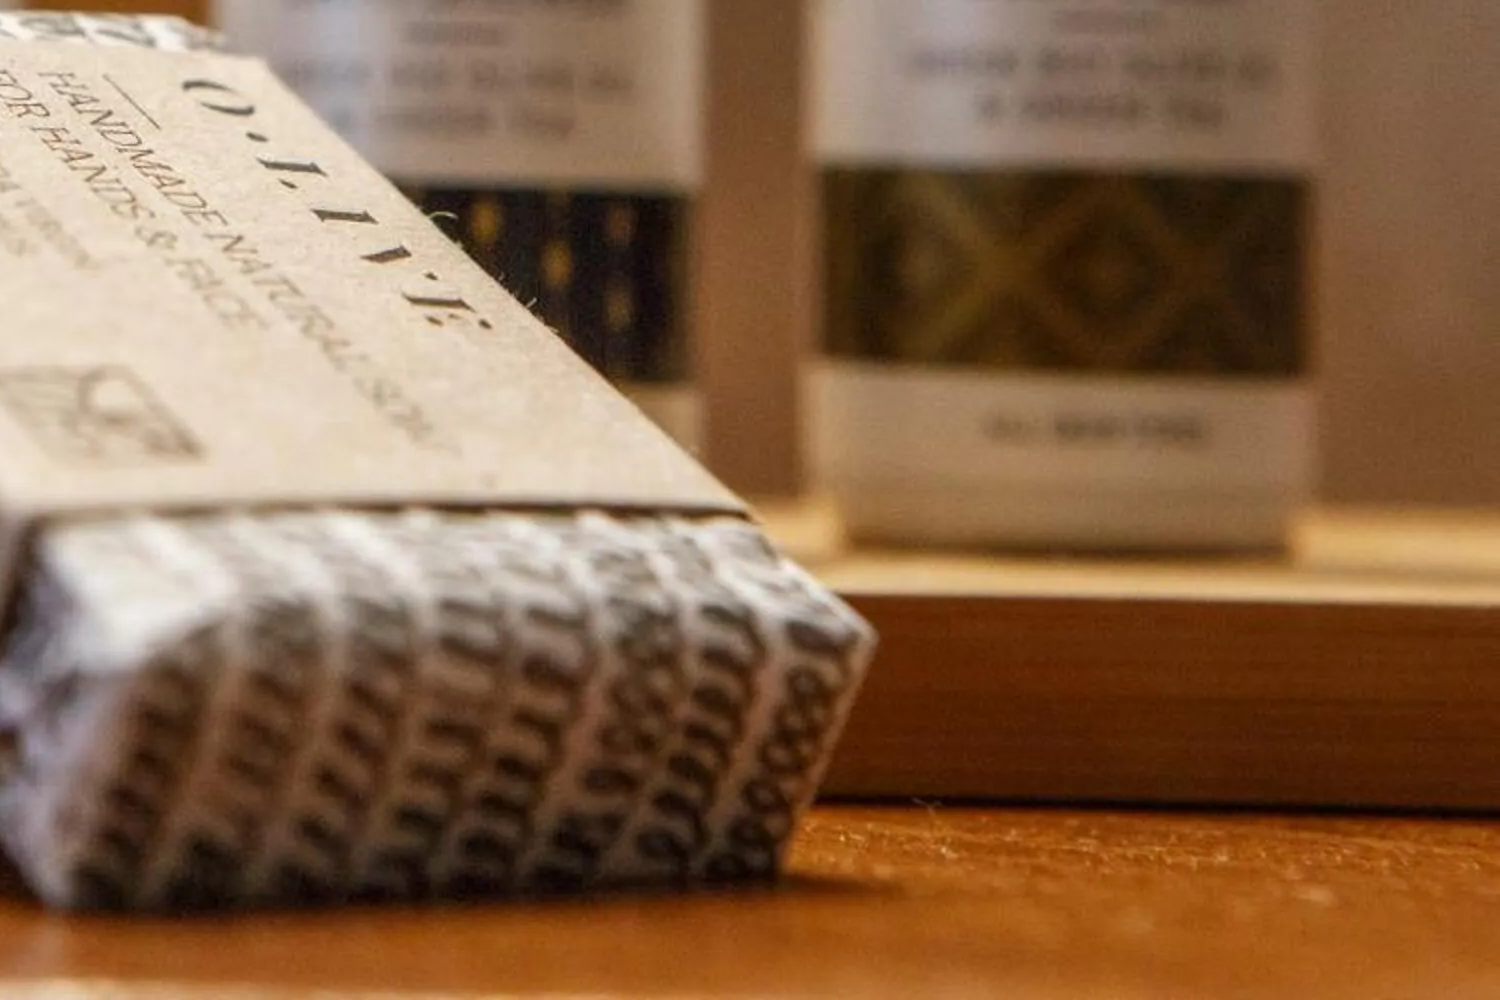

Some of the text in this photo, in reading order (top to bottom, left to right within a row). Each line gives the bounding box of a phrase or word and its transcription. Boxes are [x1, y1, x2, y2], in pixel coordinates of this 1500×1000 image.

[30, 125, 156, 222] HANDS
[133, 222, 180, 252] &
[163, 254, 272, 332] FACE
[37, 68, 229, 228] HANDMADE
